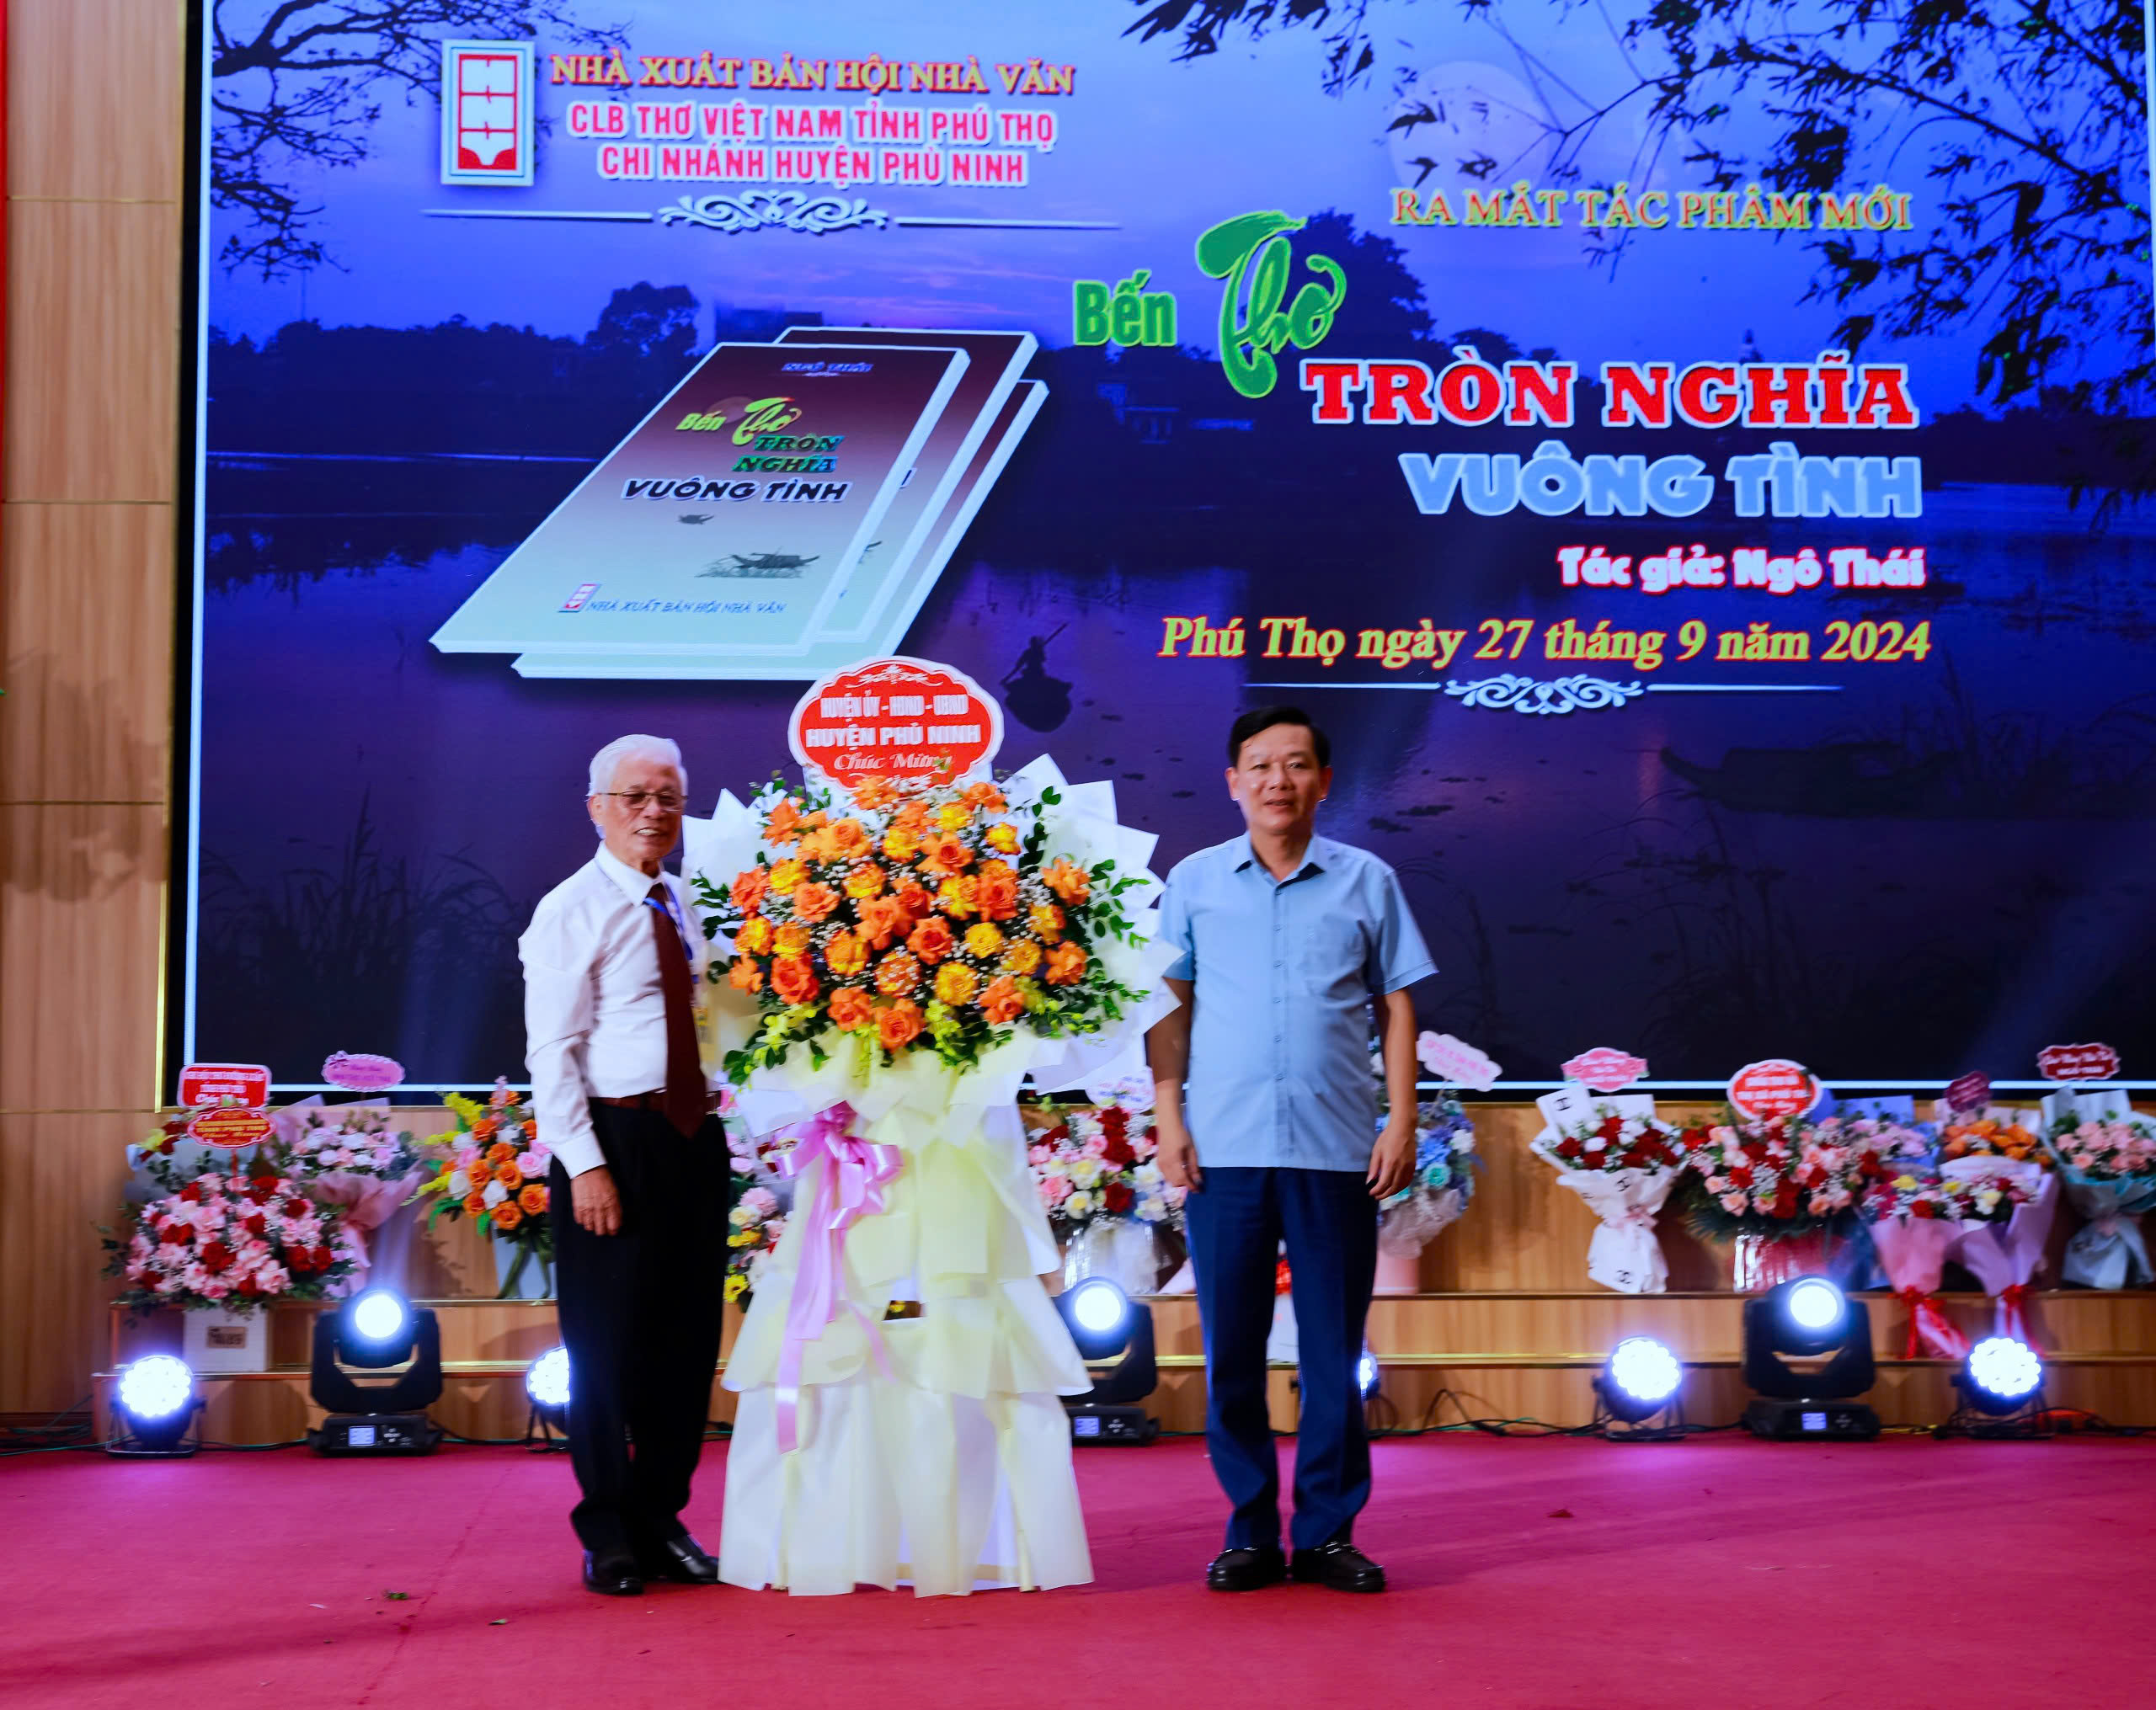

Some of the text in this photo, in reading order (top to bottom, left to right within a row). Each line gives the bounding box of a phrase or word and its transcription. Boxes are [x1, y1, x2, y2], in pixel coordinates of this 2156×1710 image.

[549, 47, 632, 86] NHÀ
[749, 51, 827, 90] BẢN
[835, 53, 901, 95] HỘI
[909, 56, 989, 93] NHÀ
[995, 58, 1075, 96] VĂN
[570, 100, 1054, 149] CLB THƠ VIỆT NAM TỈNH PHÚ THỌ
[601, 146, 650, 176] CHI
[662, 142, 764, 178] NHÁNH
[775, 145, 870, 185] HUYỆN
[952, 152, 1023, 184] NINH
[1391, 187, 1455, 226] RA
[1577, 182, 1668, 228] TÁC
[1817, 184, 1913, 230] MỚI
[1073, 210, 1347, 398] Bến Thơ
[1299, 345, 1920, 429] TRÒN NGHĨA
[676, 411, 728, 431] Bến
[624, 477, 848, 501] VUÔNG TÌNH
[1398, 439, 1924, 518] VUÔNG TÌNH
[1557, 544, 1927, 594] Tác giả: Ngô Thái
[1157, 615, 1932, 670] Phú Thọ ngày 27 tháng 9 năm 2024
[806, 723, 876, 751] HUYỆN
[927, 725, 982, 744] NINH
[834, 752, 883, 770] Chúc
